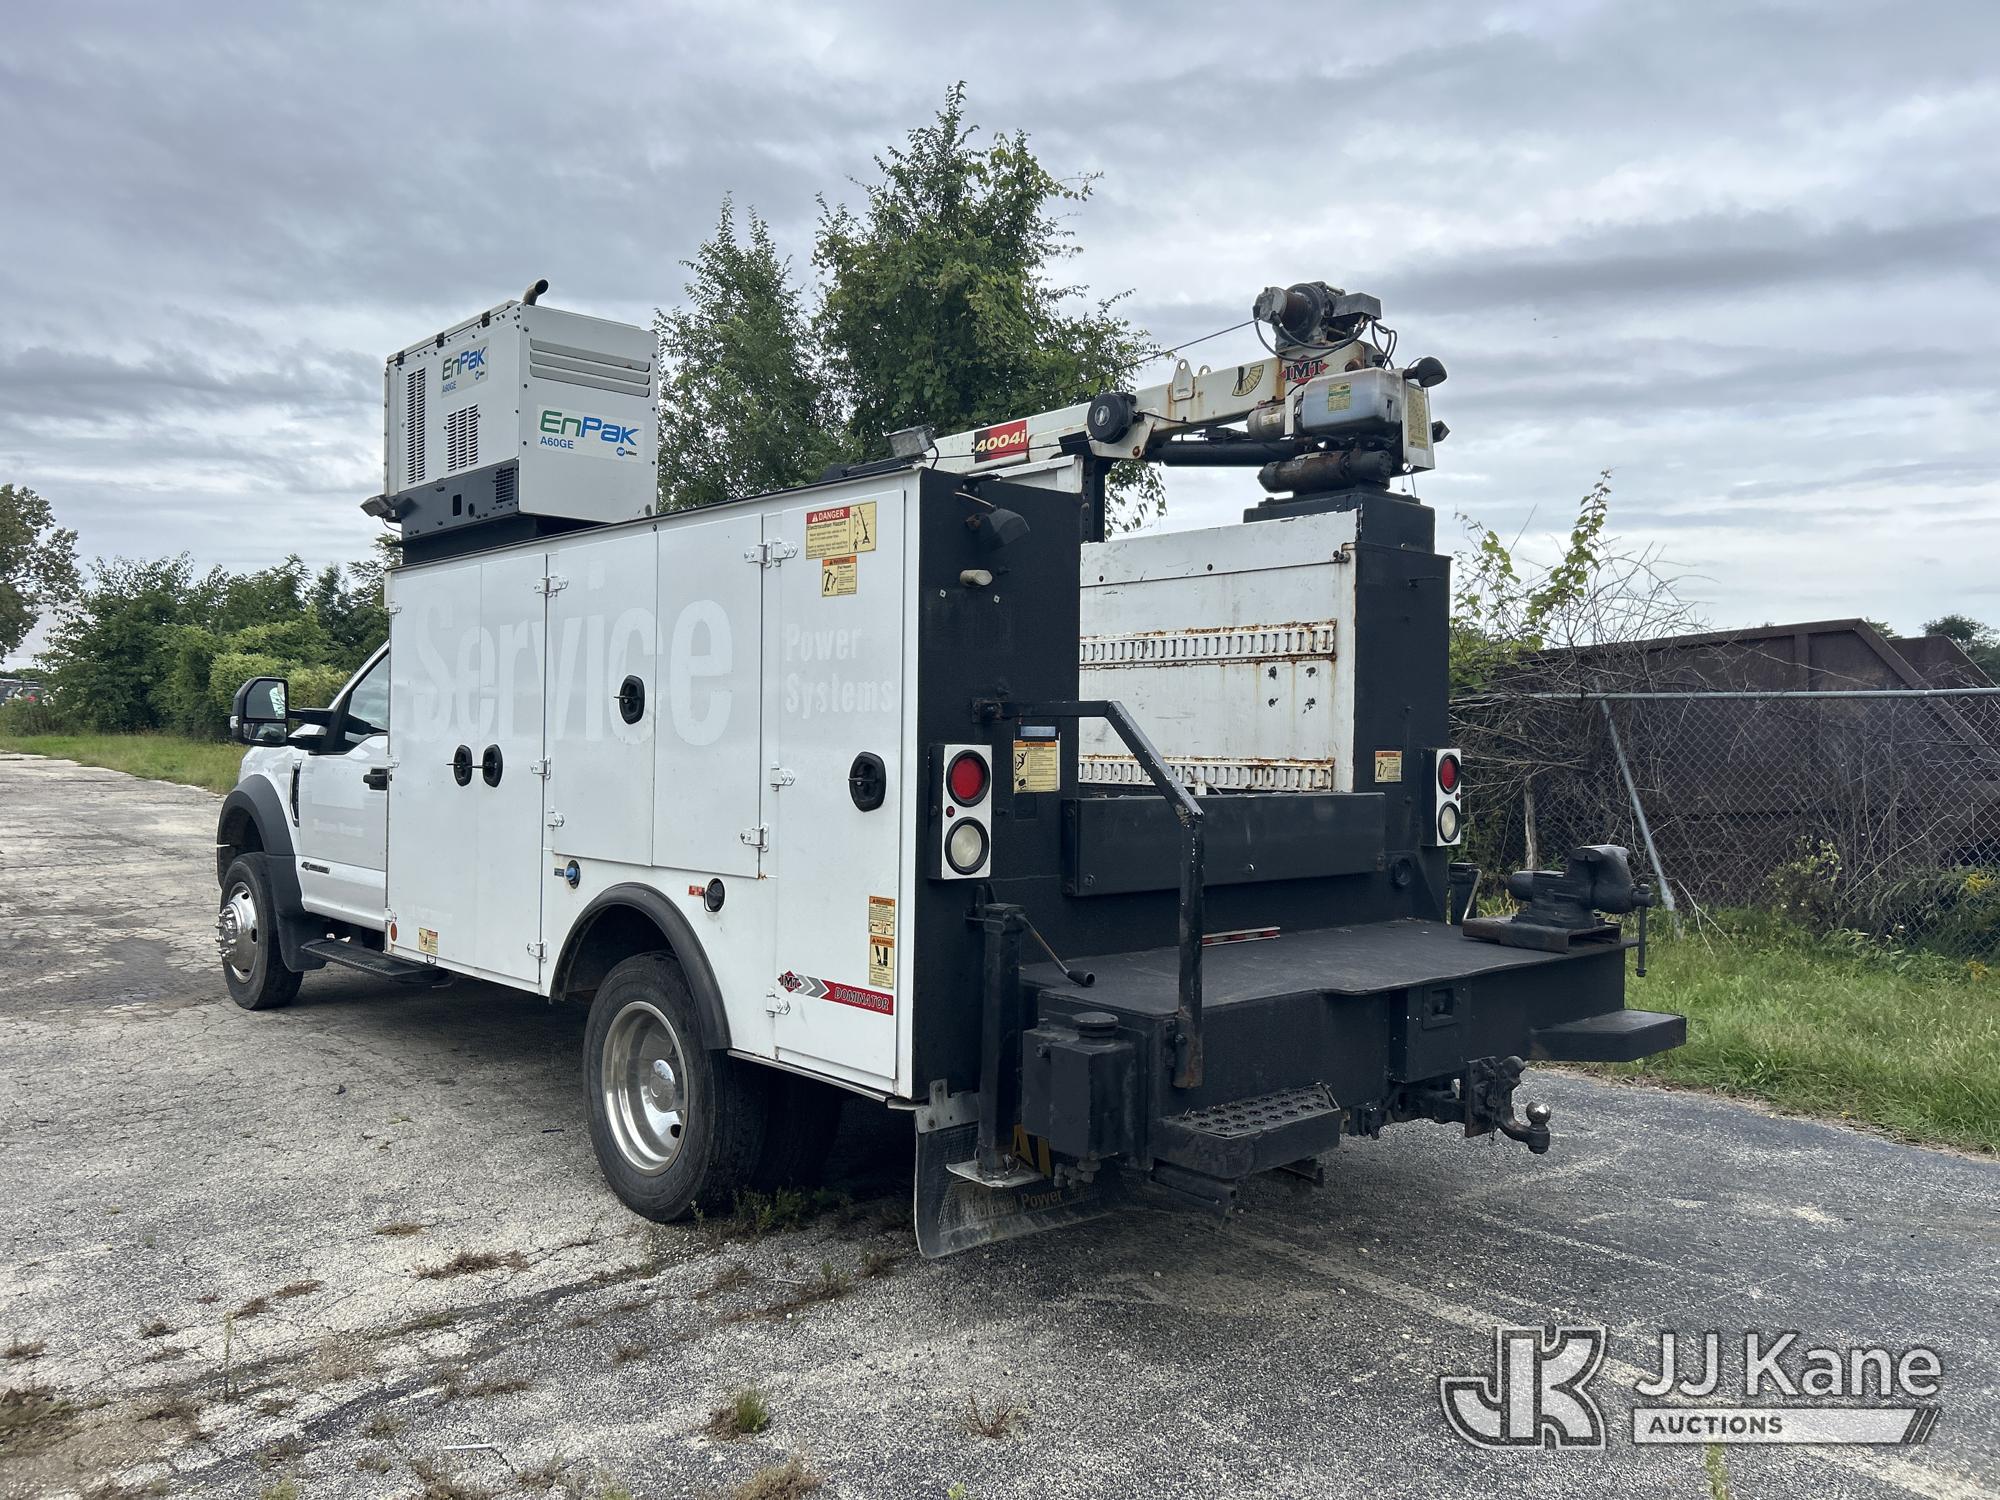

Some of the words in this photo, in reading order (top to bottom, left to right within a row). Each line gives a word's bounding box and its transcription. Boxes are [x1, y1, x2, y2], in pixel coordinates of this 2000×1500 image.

[442, 346, 487, 381] EnPak
[1285, 360, 1322, 381] IMT
[540, 410, 640, 446] EnPak
[975, 429, 1026, 452] 4004i
[540, 436, 574, 449] A60GE
[818, 509, 845, 521] DANGER
[413, 560, 733, 746] Service
[786, 623, 862, 662] Power
[785, 672, 896, 719] Systems
[834, 986, 890, 1011] DOMINATOR
[1022, 1190, 1062, 1209] Power
